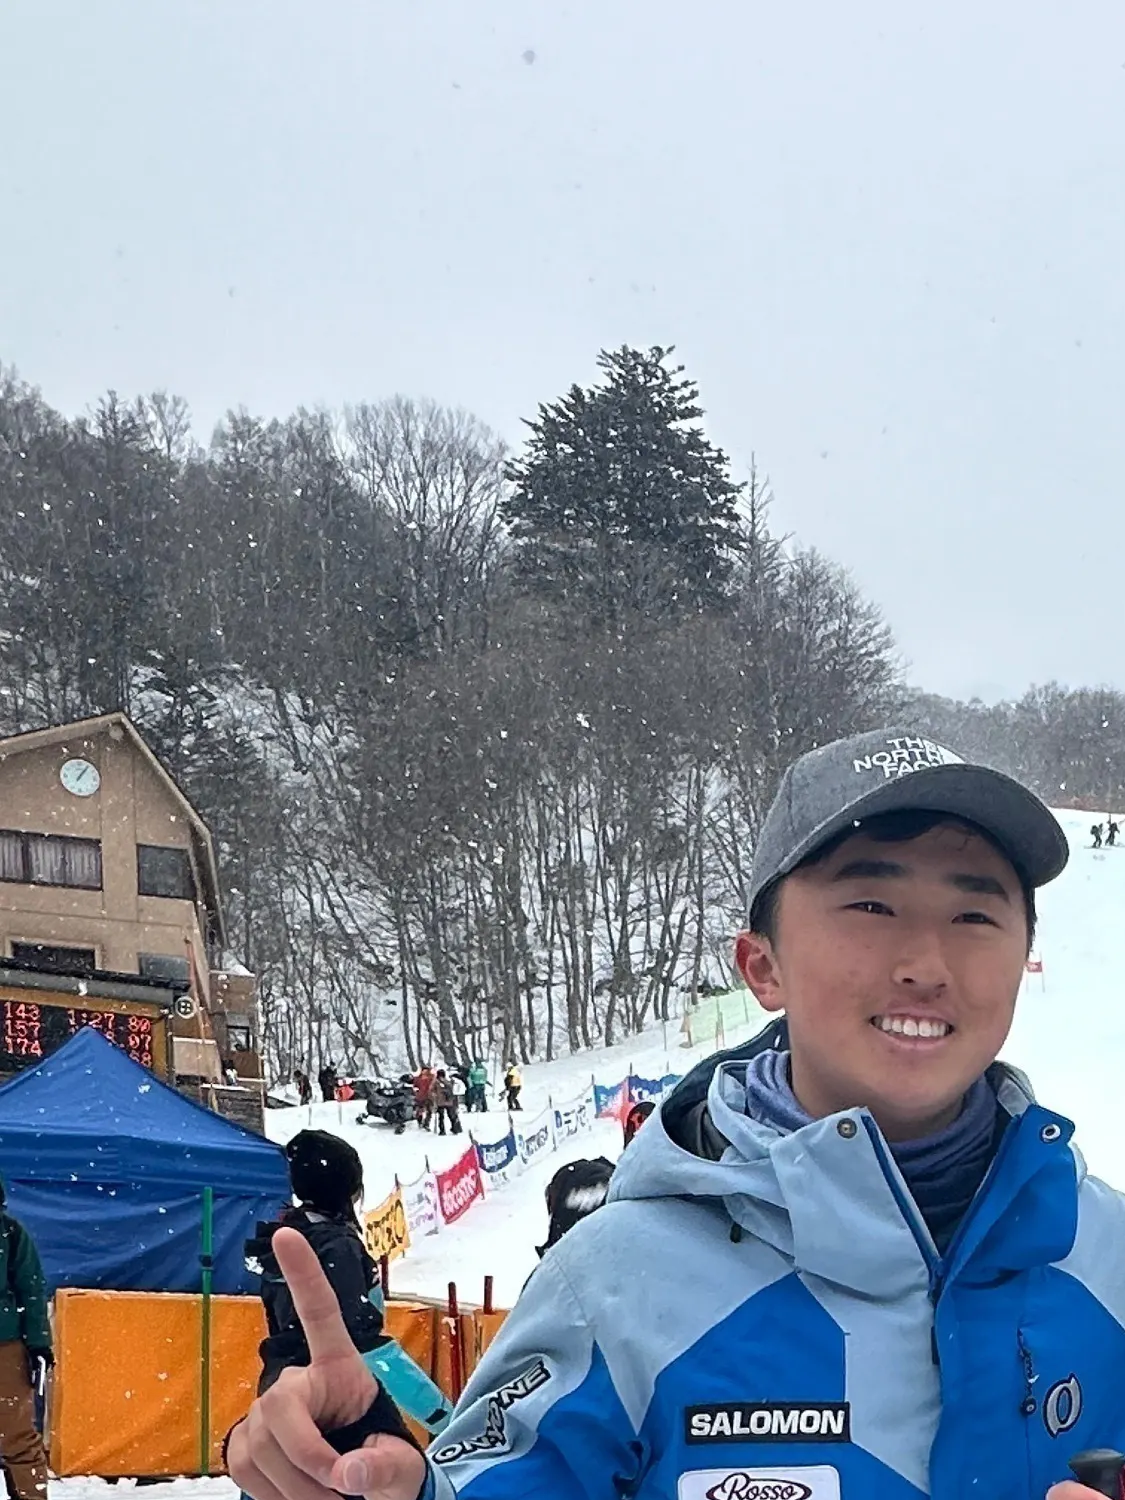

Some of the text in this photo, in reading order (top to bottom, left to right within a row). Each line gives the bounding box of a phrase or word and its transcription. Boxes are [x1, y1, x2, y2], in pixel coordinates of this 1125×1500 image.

[4, 1002, 40, 1020] 143
[4, 1019, 41, 1037] 157
[4, 1036, 43, 1057] 174
[690, 1409, 846, 1436] SALOMON
